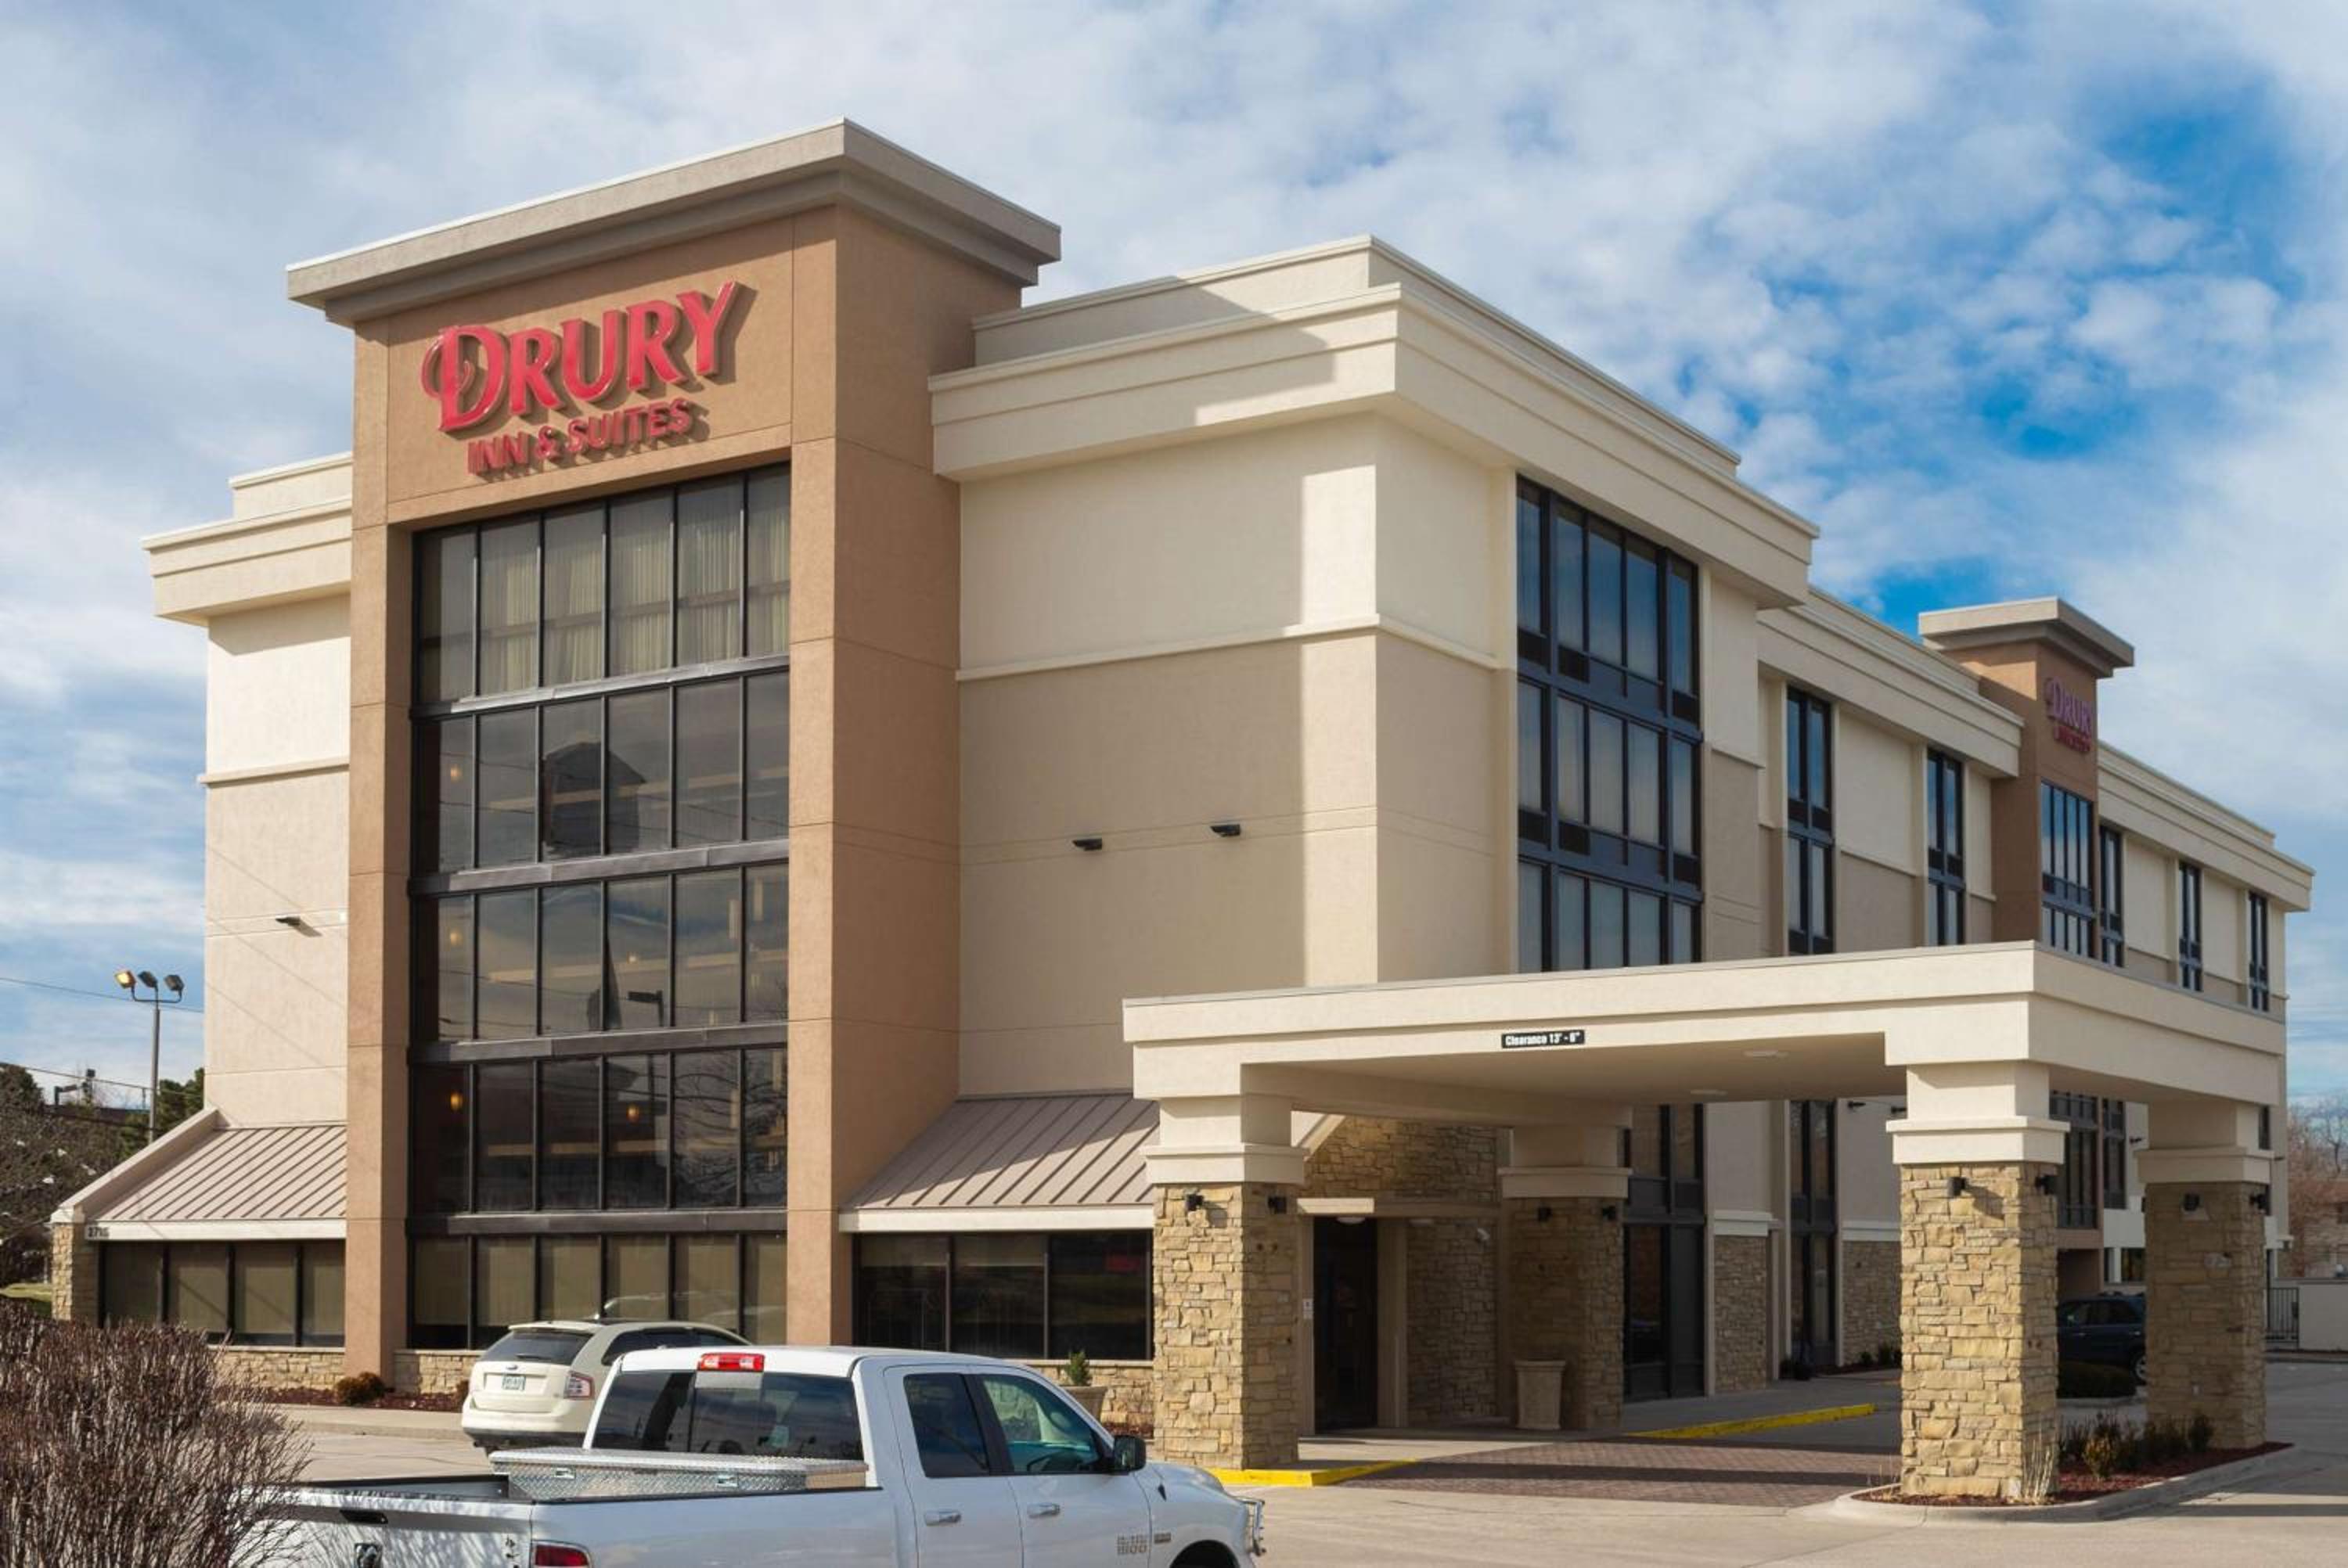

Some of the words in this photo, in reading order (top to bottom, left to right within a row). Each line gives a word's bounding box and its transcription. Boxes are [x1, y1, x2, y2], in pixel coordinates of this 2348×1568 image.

[420, 279, 736, 432] DRURY
[468, 430, 529, 476] INN
[534, 425, 562, 461] &
[567, 397, 693, 456] SUITES
[1505, 1034, 1547, 1047] Clearance
